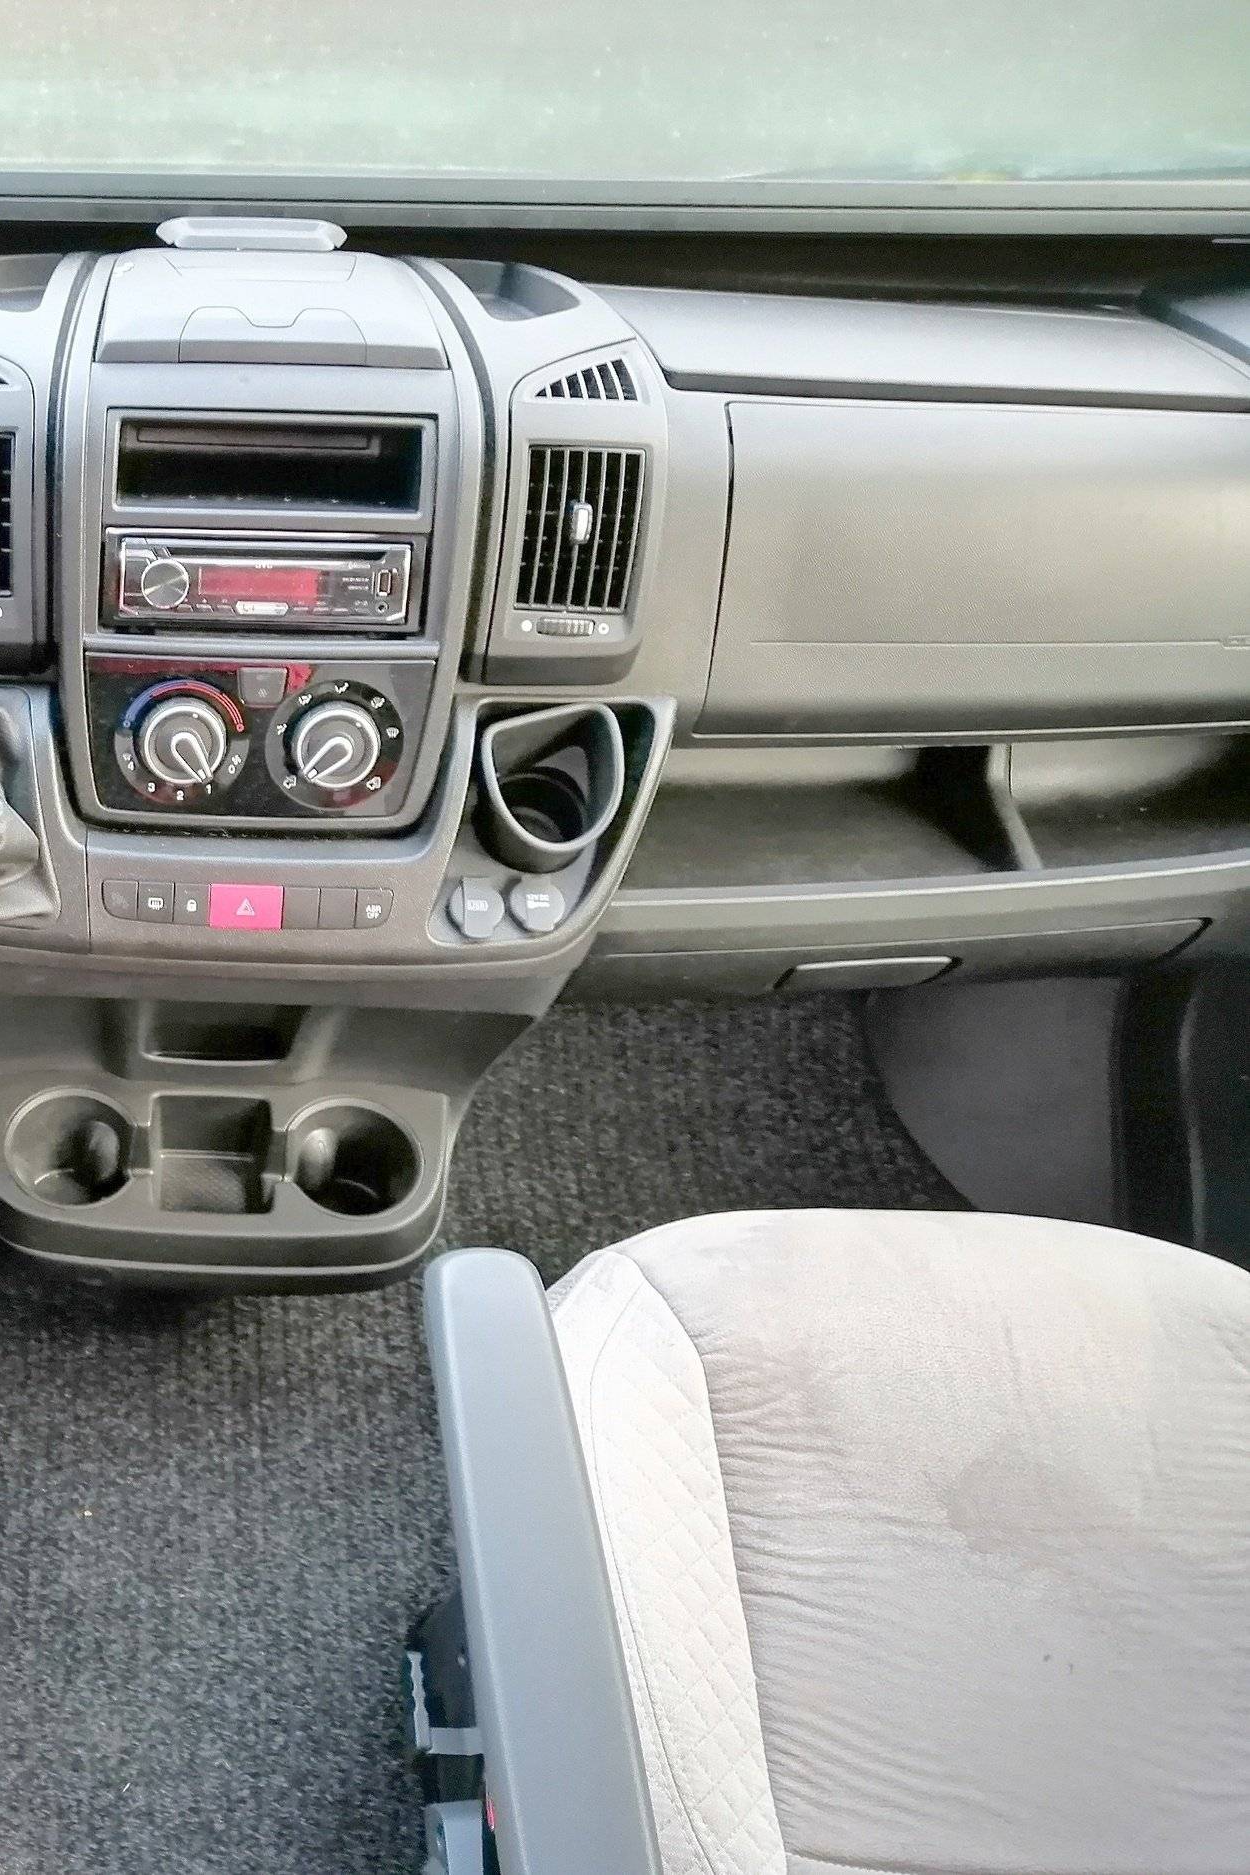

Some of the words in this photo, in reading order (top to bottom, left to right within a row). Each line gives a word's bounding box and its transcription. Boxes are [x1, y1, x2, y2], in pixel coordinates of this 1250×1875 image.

[127, 760, 136, 771] 4
[147, 781, 156, 793] 3
[205, 783, 212, 794] 1
[176, 789, 185, 801] 2
